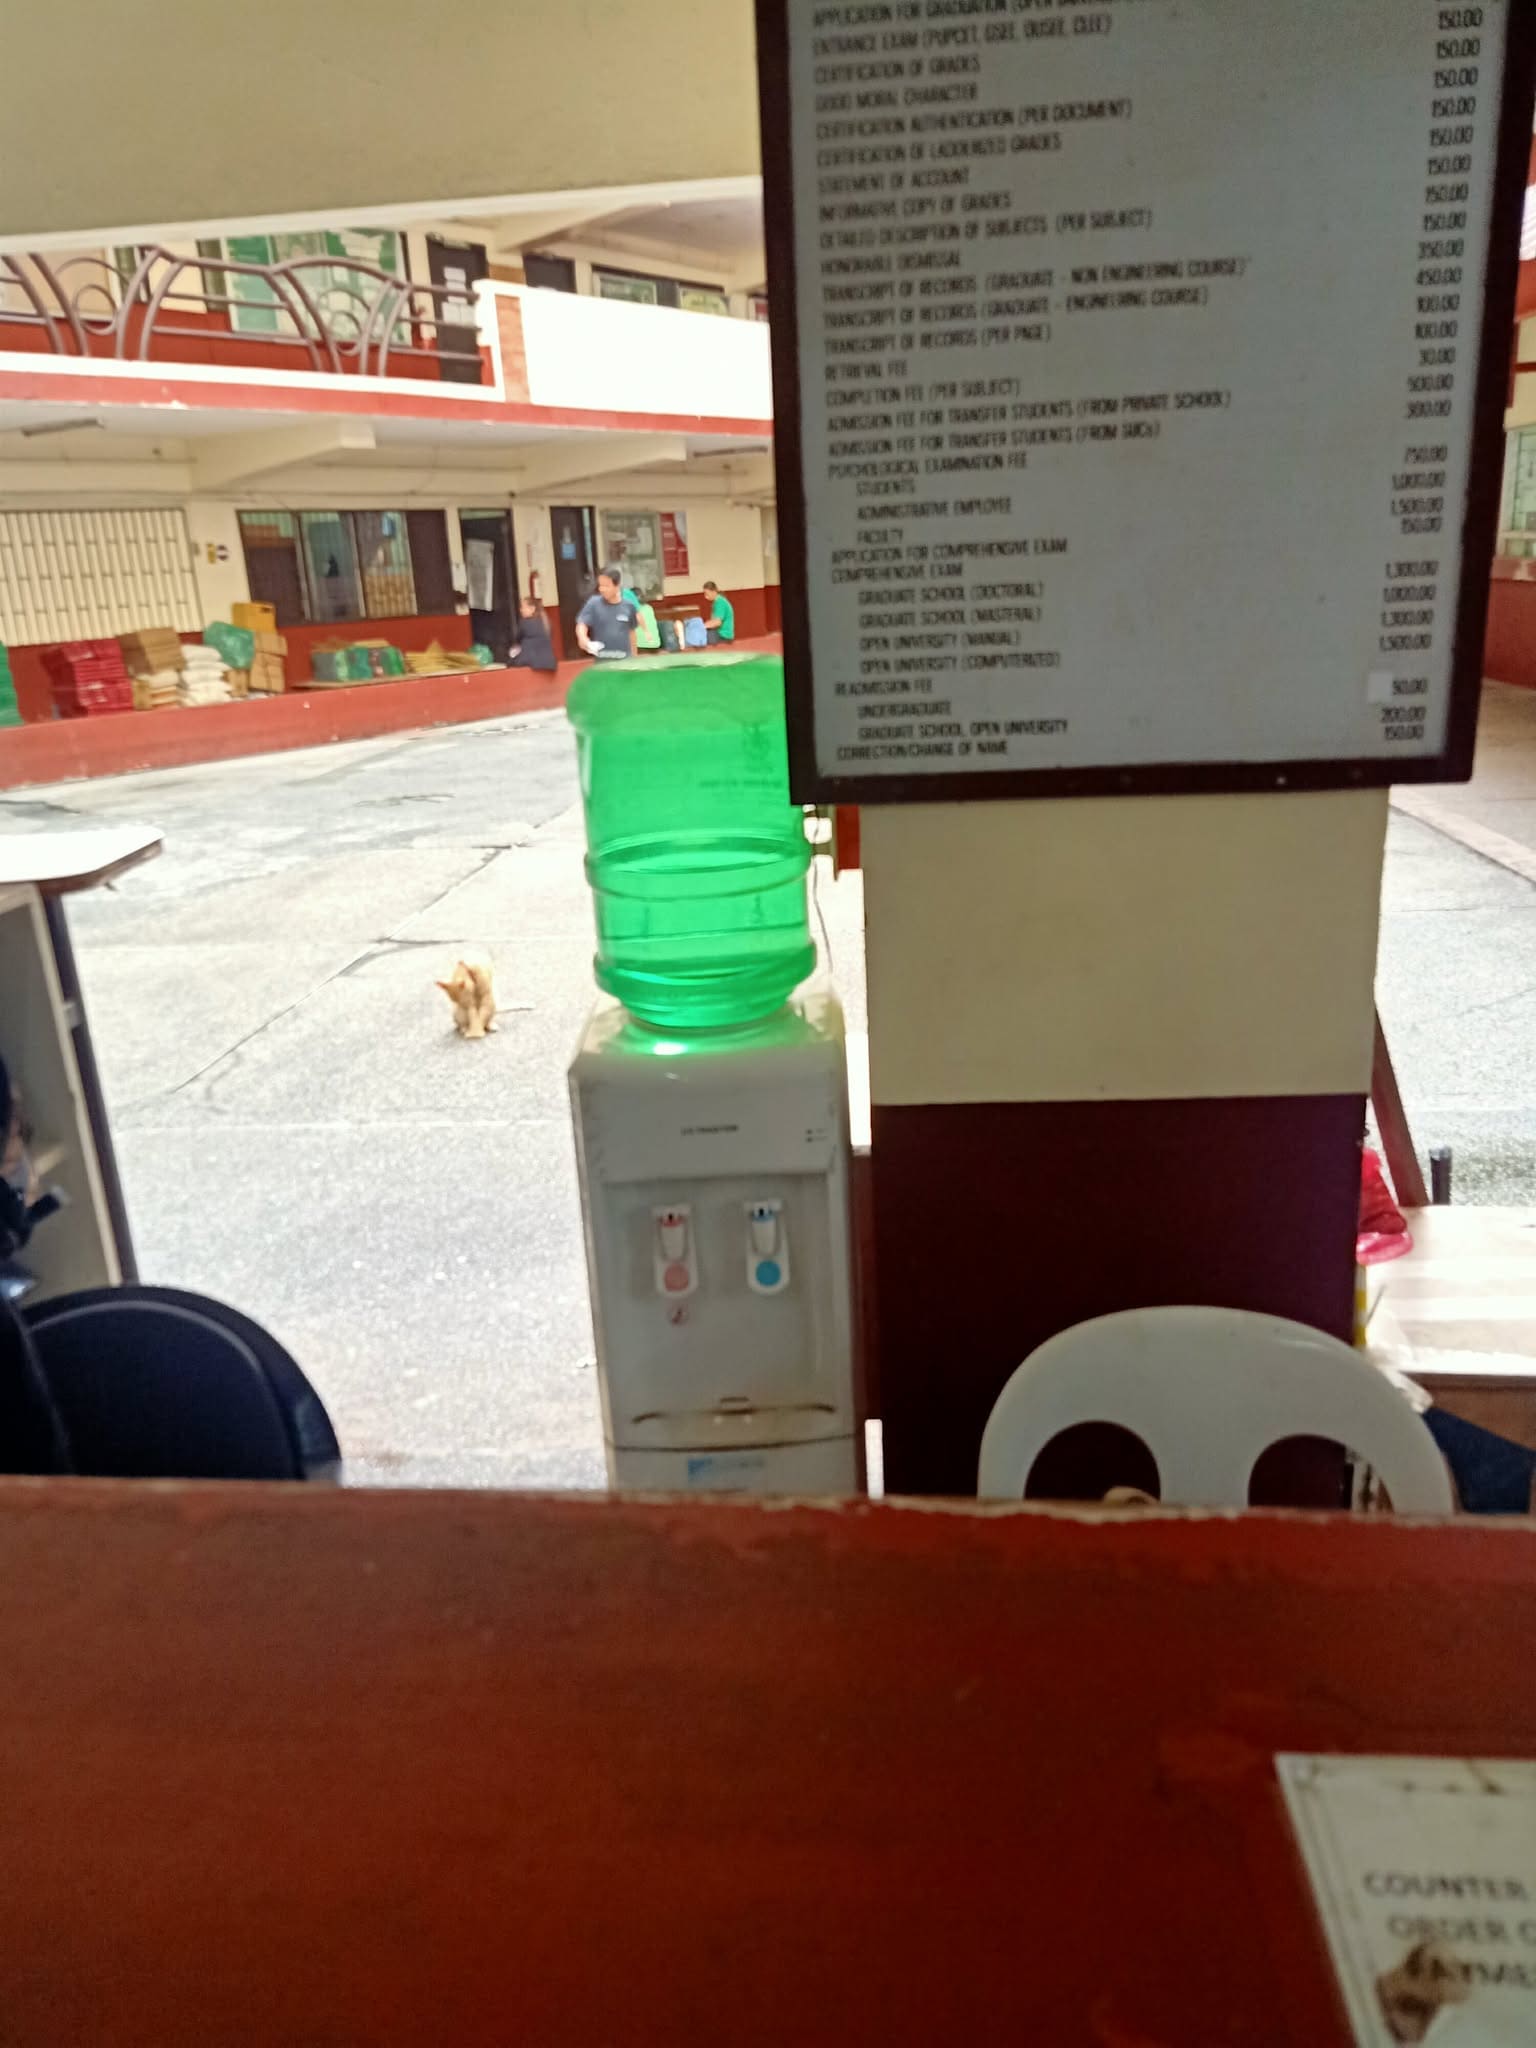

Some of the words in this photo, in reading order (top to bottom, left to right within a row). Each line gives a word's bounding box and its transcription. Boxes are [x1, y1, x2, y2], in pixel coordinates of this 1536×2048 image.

[1436, 37, 1480, 59] 150.00
[1433, 67, 1479, 88] 150.00
[1363, 1869, 1529, 1901] COUNTER
